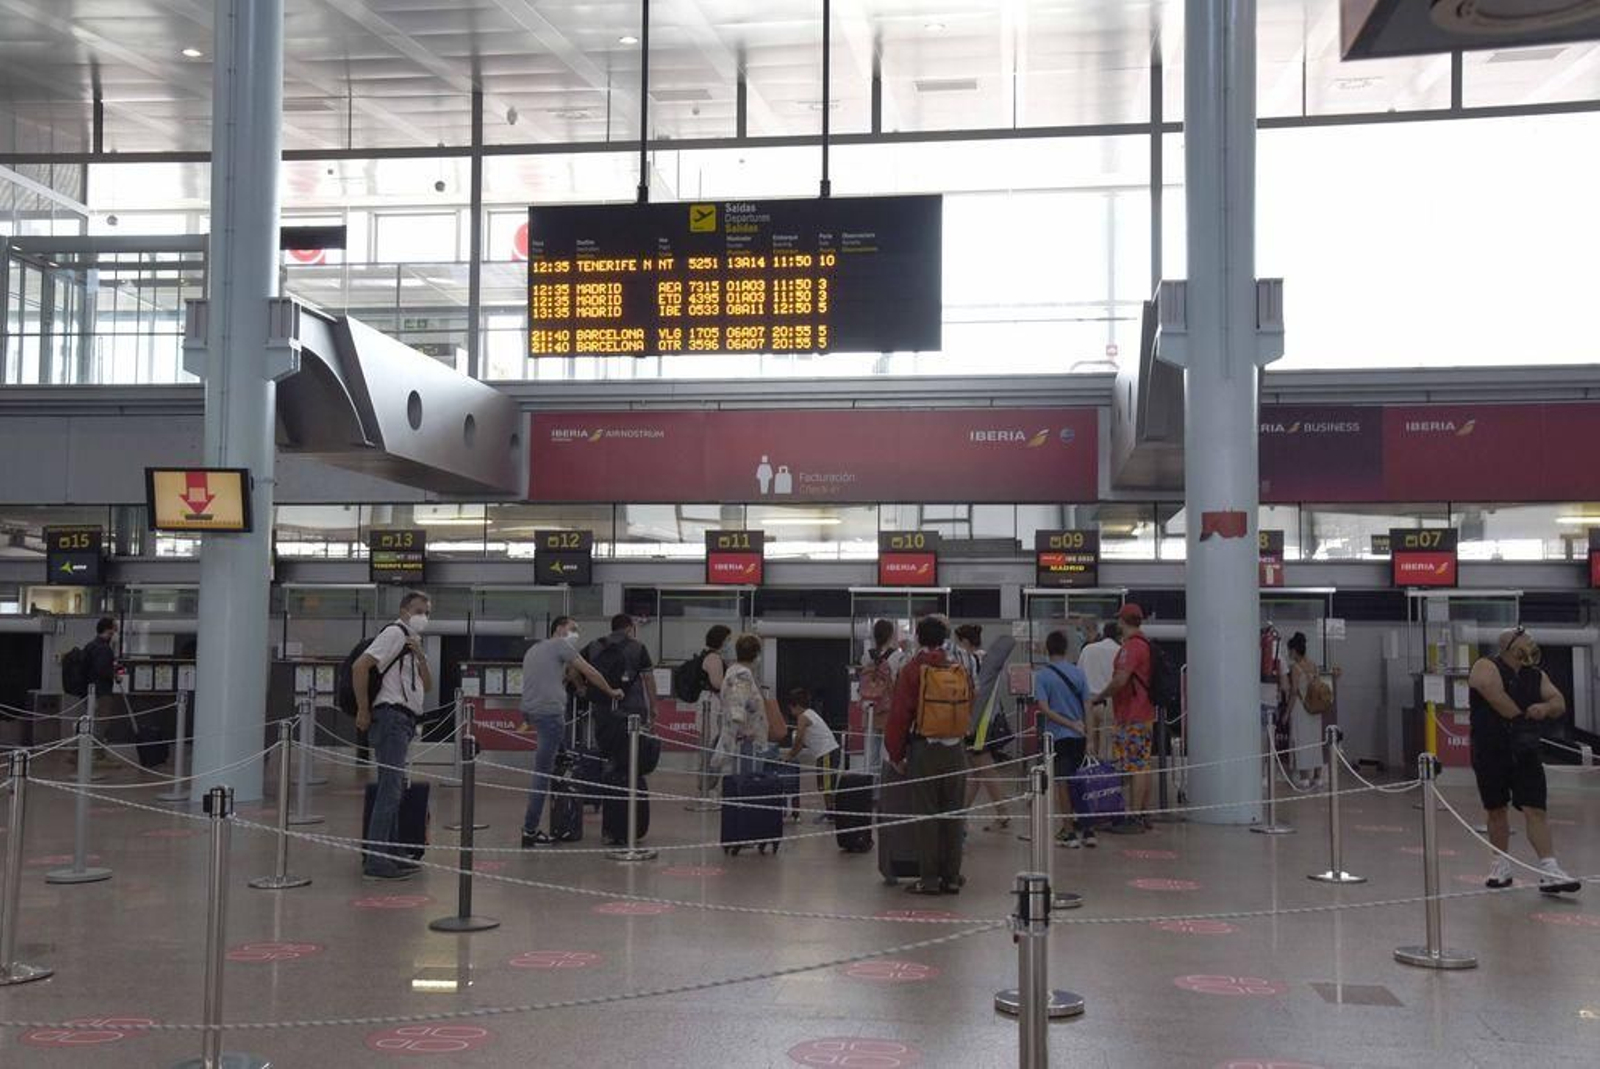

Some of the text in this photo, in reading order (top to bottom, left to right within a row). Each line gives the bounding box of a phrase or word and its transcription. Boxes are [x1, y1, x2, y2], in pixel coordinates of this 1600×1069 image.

[533, 255, 836, 273] 12:35 TENERIFE N NT 5251 13A14 11:50 10
[533, 278, 828, 296] 12:35 MADRID AEA 7315 01A03 11:50 3
[533, 290, 828, 307] 12:35 MADRID ETD 4395 01A03 11:50 3
[533, 307, 570, 319] 13:35
[576, 305, 622, 317] MADRID
[658, 305, 682, 317] IBE
[688, 304, 720, 316] 0533
[773, 302, 812, 314] 12:50
[818, 302, 828, 313] 5
[531, 330, 570, 342] 21:40
[576, 328, 645, 341] BARCELONA
[658, 328, 682, 340] VLG
[688, 327, 720, 340] 1705
[772, 325, 812, 338] 20:55
[818, 325, 828, 337] 5
[531, 341, 570, 353] 21:40
[576, 340, 645, 352] BARCELONA
[658, 340, 682, 351] QTR
[772, 338, 812, 350] 20:55
[818, 337, 828, 349] 5
[551, 429, 588, 438] IBERIA
[1260, 422, 1360, 433] RIA BUSINESS
[1405, 421, 1456, 432] IBERIA
[969, 430, 1026, 442] IBERIA
[71, 533, 90, 548] 15
[394, 532, 413, 548] 13
[560, 533, 580, 548] 12
[731, 533, 751, 548] 11
[904, 533, 925, 549] 10
[1063, 532, 1084, 548] 09
[1259, 532, 1269, 549] 8
[1419, 531, 1442, 548] 07
[714, 563, 744, 571] IBERIA
[886, 563, 917, 571] IBERIA
[1401, 562, 1435, 571] IBERIA
[669, 722, 696, 731] IBER
